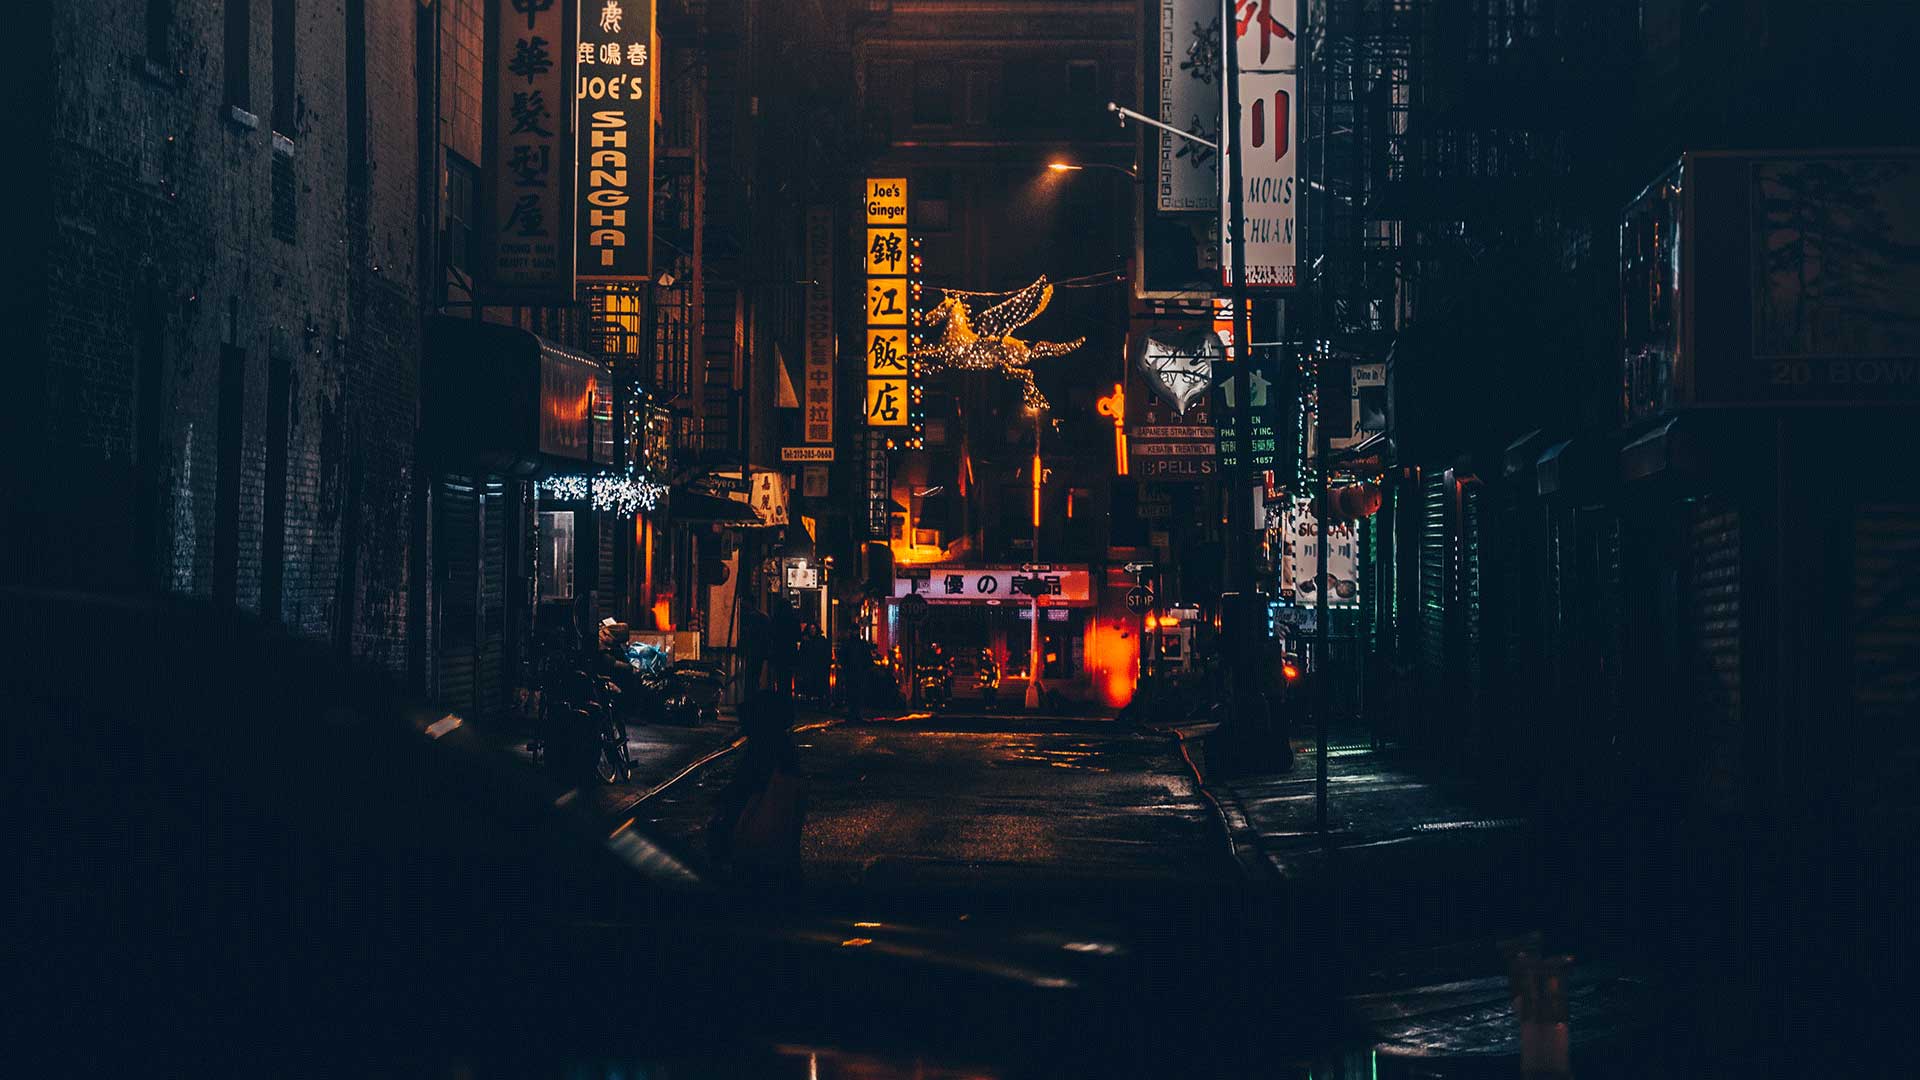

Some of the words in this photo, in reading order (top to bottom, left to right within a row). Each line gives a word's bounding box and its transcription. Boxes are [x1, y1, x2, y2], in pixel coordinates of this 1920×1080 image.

[577, 42, 647, 67] 鹿鳴春
[578, 73, 643, 100] JOE'S
[587, 110, 630, 267] SHANGHAI
[873, 183, 900, 198] Joe's
[868, 203, 905, 218] Ginger
[869, 231, 905, 422] 錦江飯店
[1158, 460, 1197, 474] PELL
